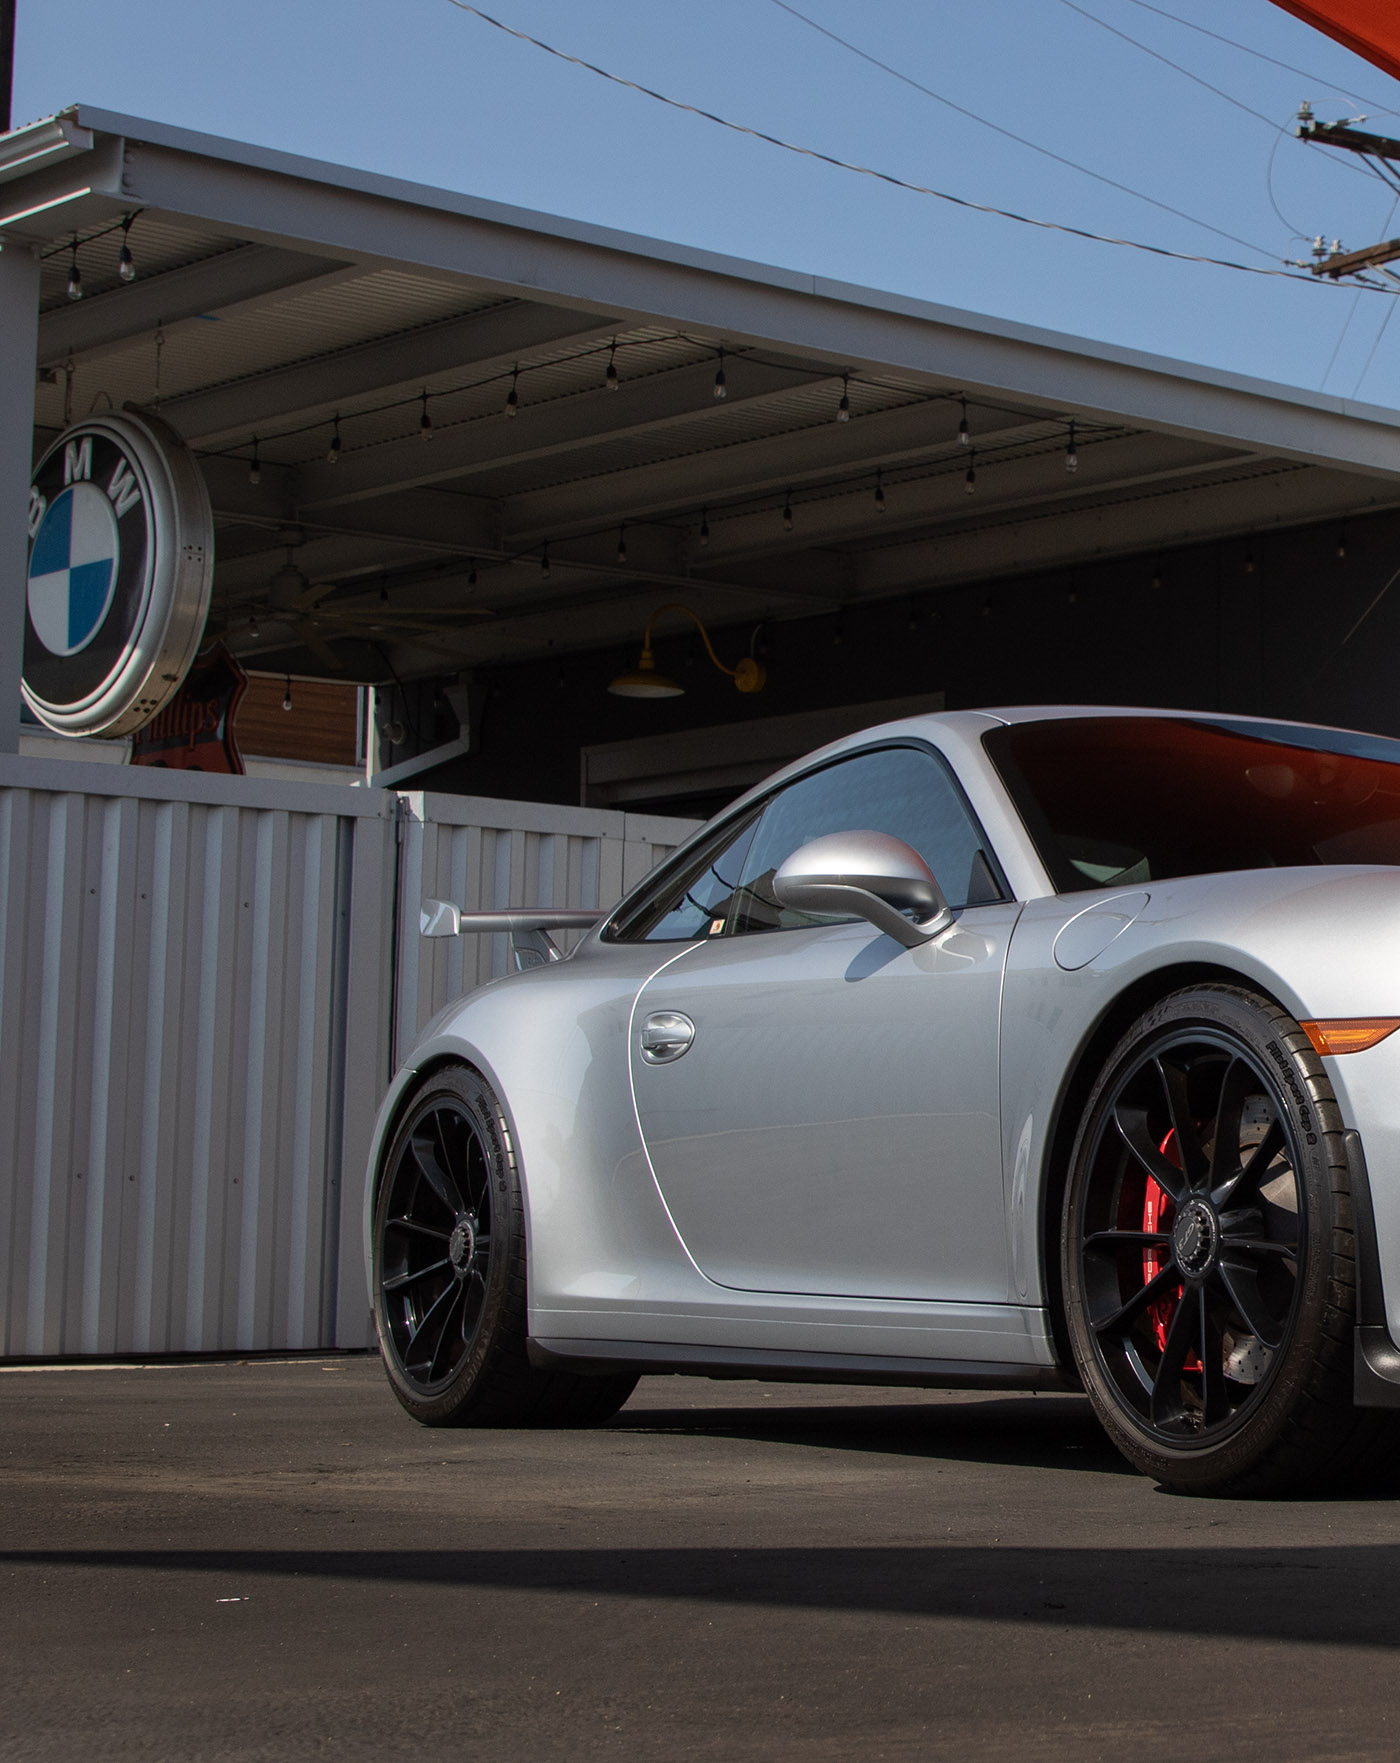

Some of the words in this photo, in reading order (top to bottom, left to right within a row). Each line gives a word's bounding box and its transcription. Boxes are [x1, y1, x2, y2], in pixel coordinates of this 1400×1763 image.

[28, 436, 141, 539] BMW
[1265, 1040, 1288, 1069] Pilot
[1282, 1067, 1305, 1105] Sport
